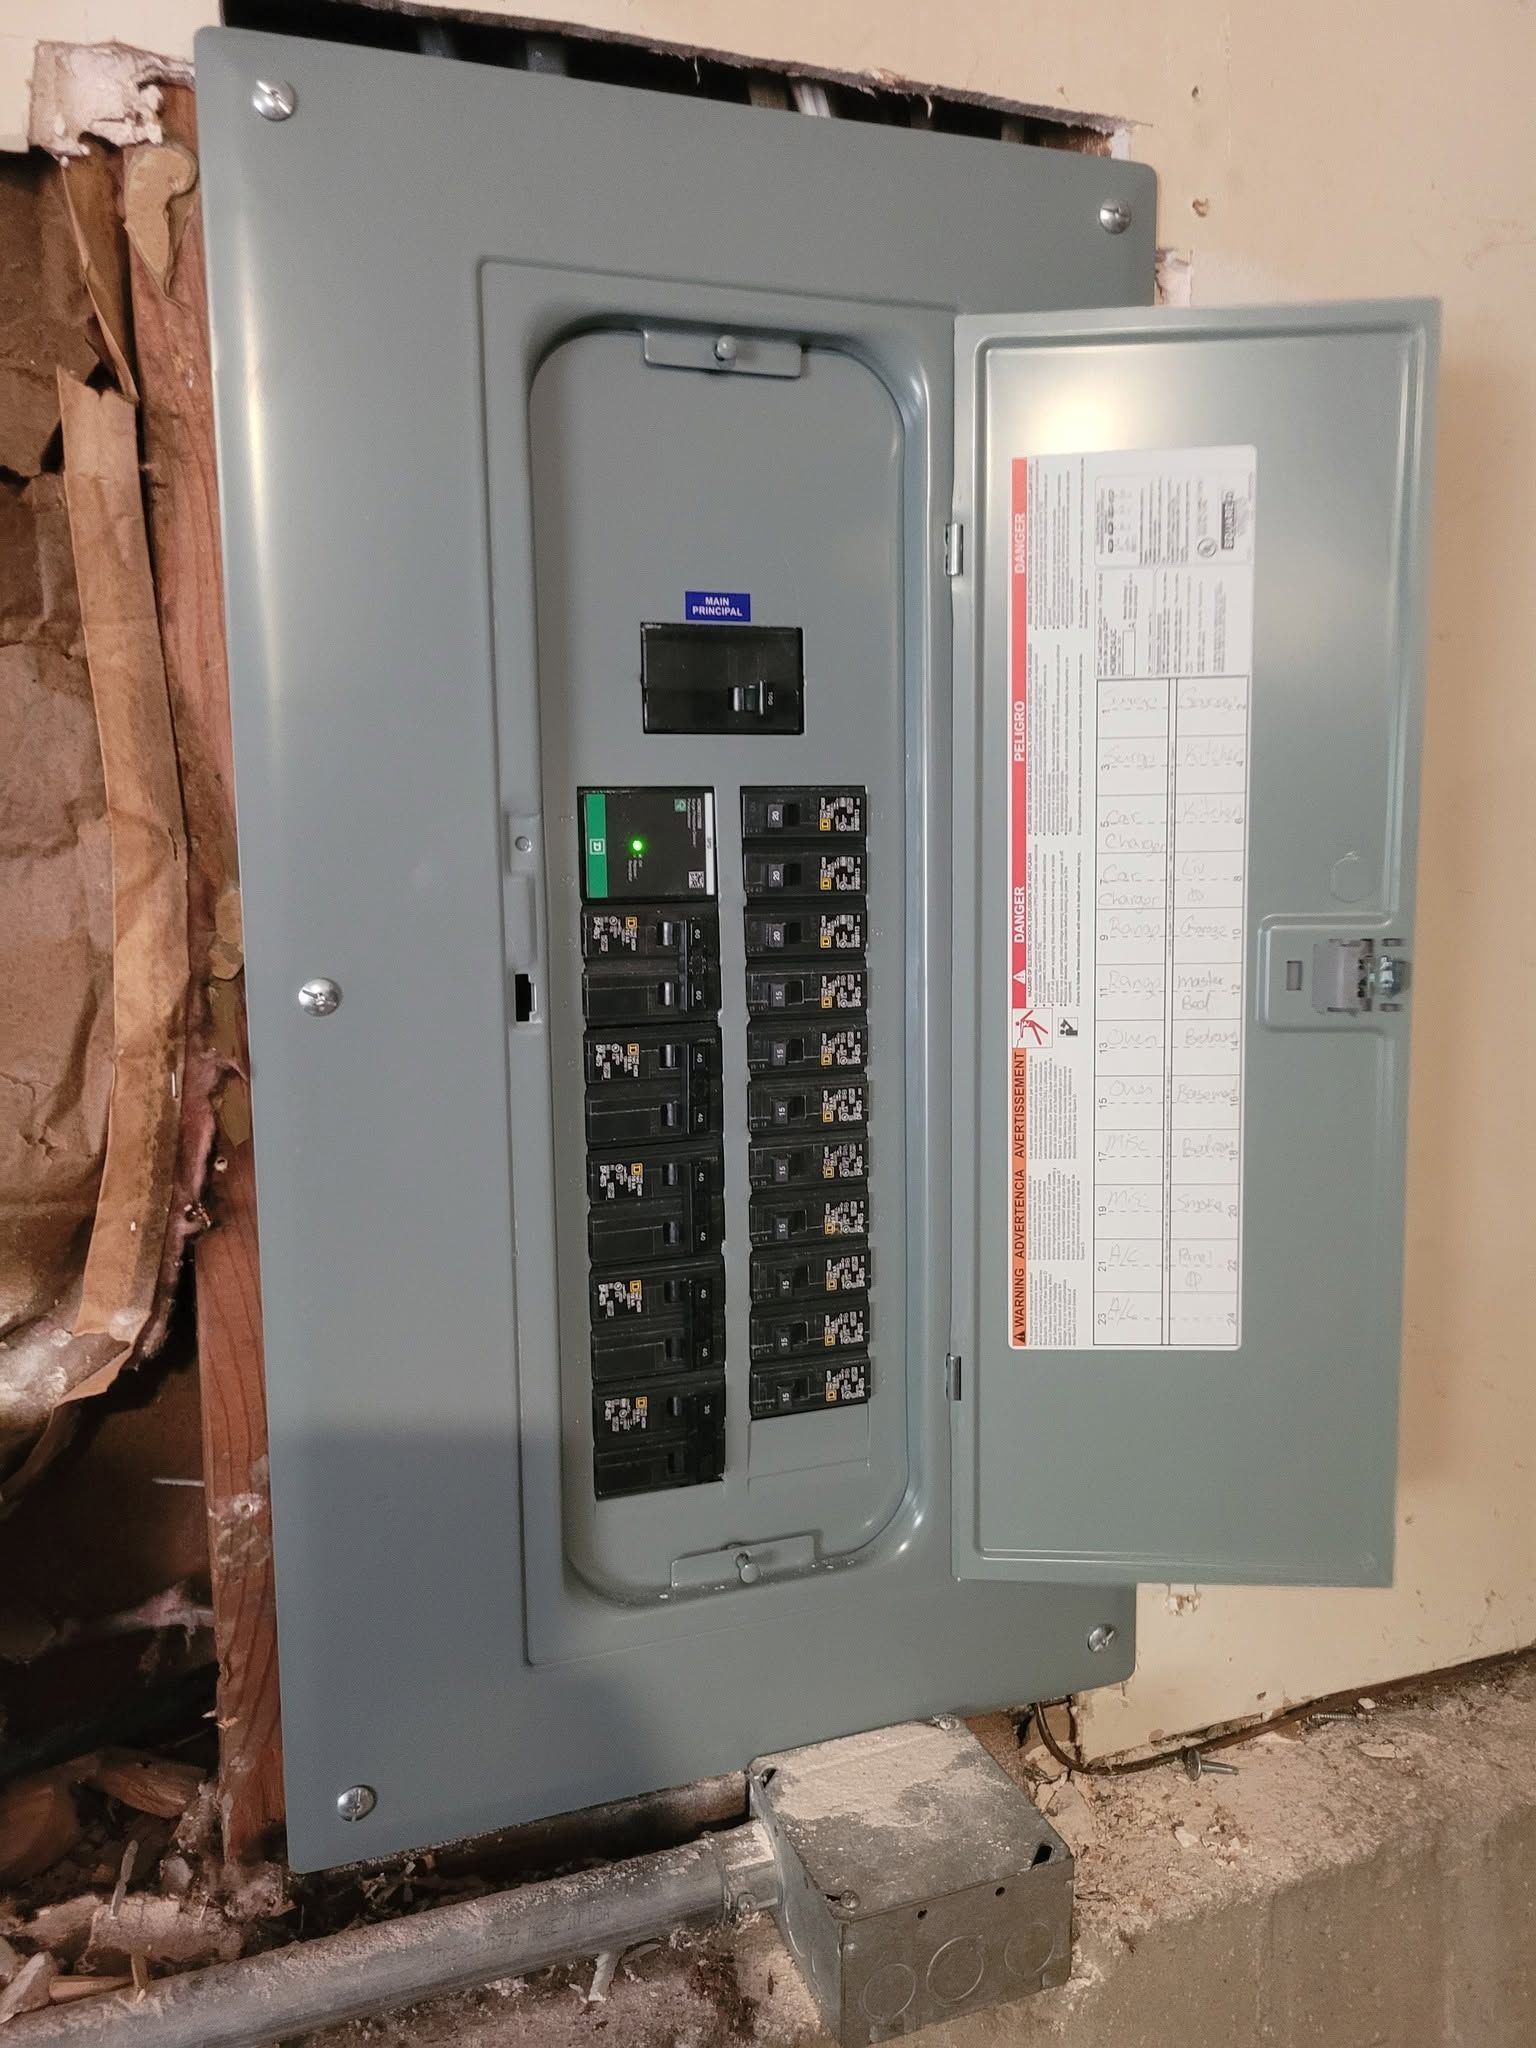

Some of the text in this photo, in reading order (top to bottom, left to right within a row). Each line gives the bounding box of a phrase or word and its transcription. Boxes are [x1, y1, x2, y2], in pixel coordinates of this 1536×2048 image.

[1014, 513, 1025, 574] DANGER
[705, 597, 729, 606] MAIN
[692, 606, 742, 616] PRINCIPAL
[1014, 701, 1025, 762] PELIGRO
[772, 811, 779, 820] 20
[773, 871, 779, 881] 20
[1103, 864, 1141, 881] Car
[1014, 886, 1025, 943] DANGER
[773, 931, 780, 940] 20
[1232, 929, 1241, 939] 10
[1100, 987, 1108, 997] 11
[1231, 984, 1241, 994] 12
[776, 991, 782, 1000] 15
[1107, 1029, 1158, 1045] Oven
[1099, 1042, 1108, 1054] 13
[1231, 1041, 1238, 1051] 14
[777, 1049, 783, 1058] 15
[1099, 1097, 1108, 1109] 15
[1230, 1096, 1239, 1107] 16
[779, 1107, 784, 1116] 15
[1099, 1152, 1107, 1162] 17
[1230, 1150, 1238, 1160] 18
[779, 1166, 786, 1175] 15
[1014, 1052, 1024, 1327] WARNING ADVERTENCIA AVERTISSEMENT
[1099, 1206, 1107, 1216] 19
[1228, 1205, 1238, 1217] 20
[779, 1224, 785, 1232] 15
[1098, 1261, 1107, 1272] 21
[1227, 1260, 1237, 1272] 22
[782, 1281, 789, 1289] 15
[1098, 1313, 1107, 1325] 23
[1227, 1313, 1237, 1327] 24
[781, 1338, 788, 1347] 15
[782, 1393, 789, 1402] 15
